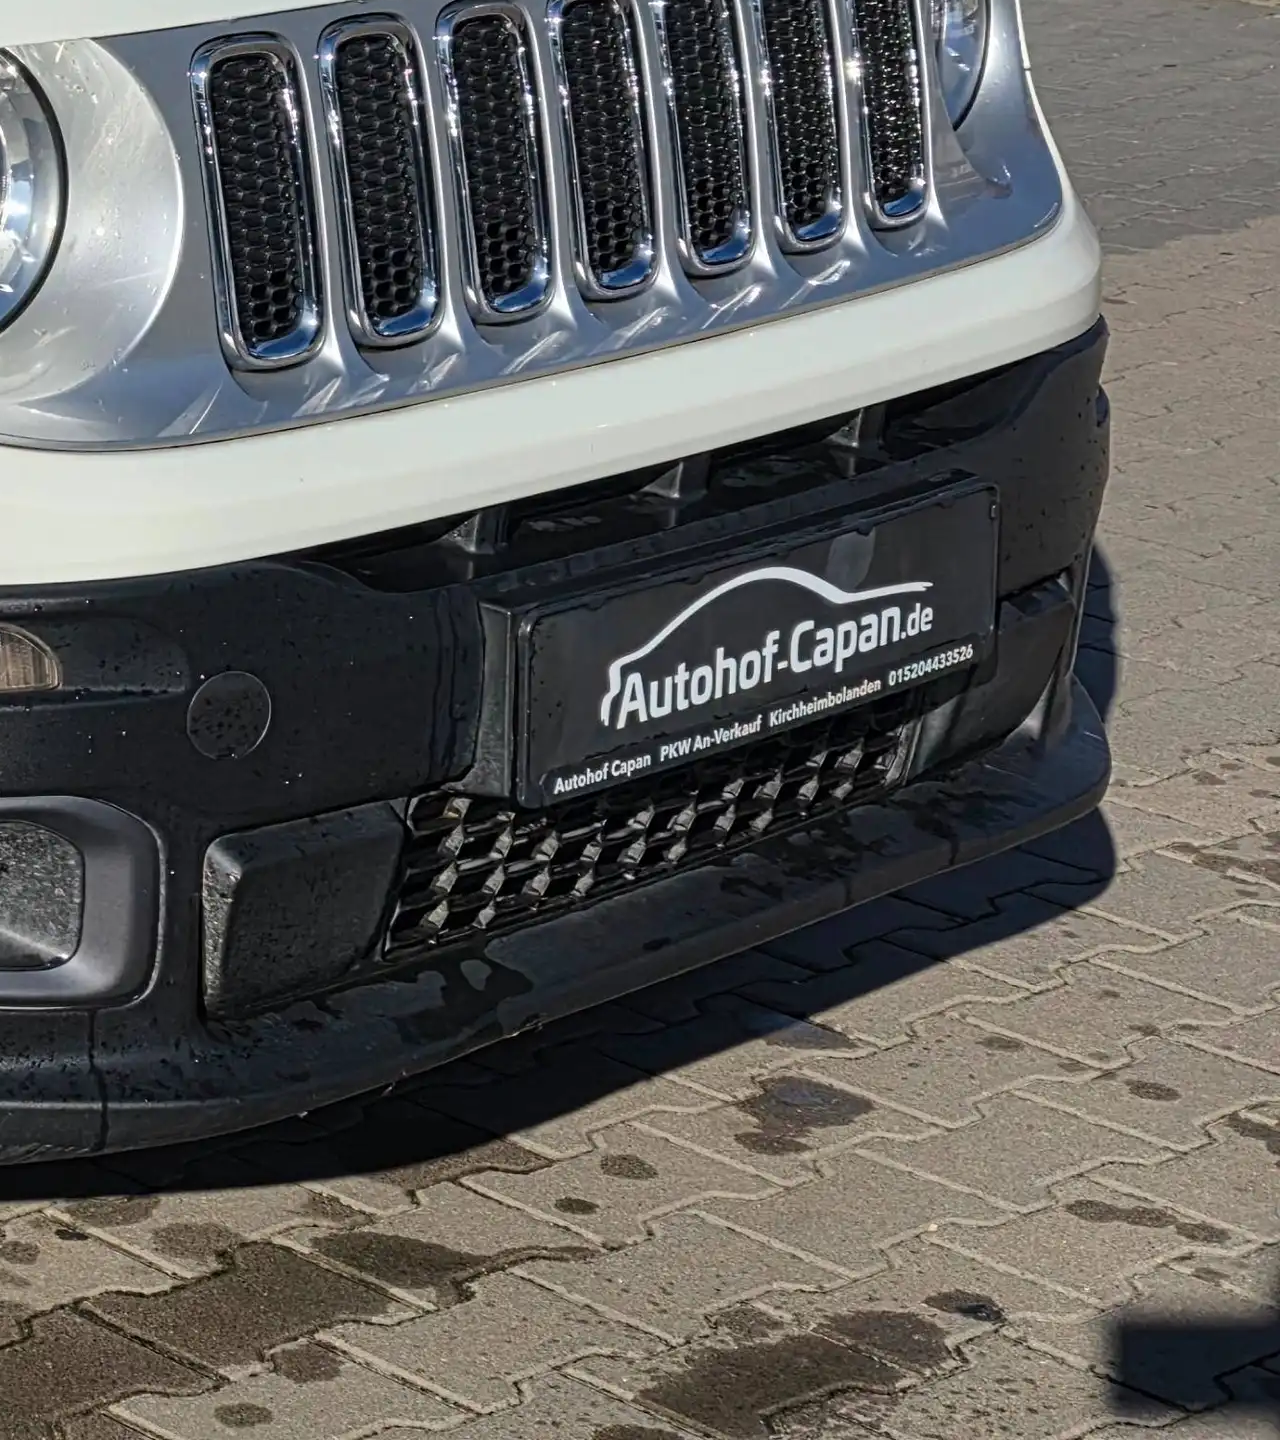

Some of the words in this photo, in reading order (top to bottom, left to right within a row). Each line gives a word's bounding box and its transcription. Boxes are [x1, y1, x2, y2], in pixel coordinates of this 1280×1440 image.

[553, 762, 609, 795] Autohof
[611, 753, 652, 777] Capan
[659, 737, 692, 762] PKW
[692, 714, 763, 752] An-Verkauf
[769, 678, 882, 727] Kirchheimbolanden
[888, 643, 974, 686] 015204433526
[616, 602, 934, 730] Autohof-Capan.de
